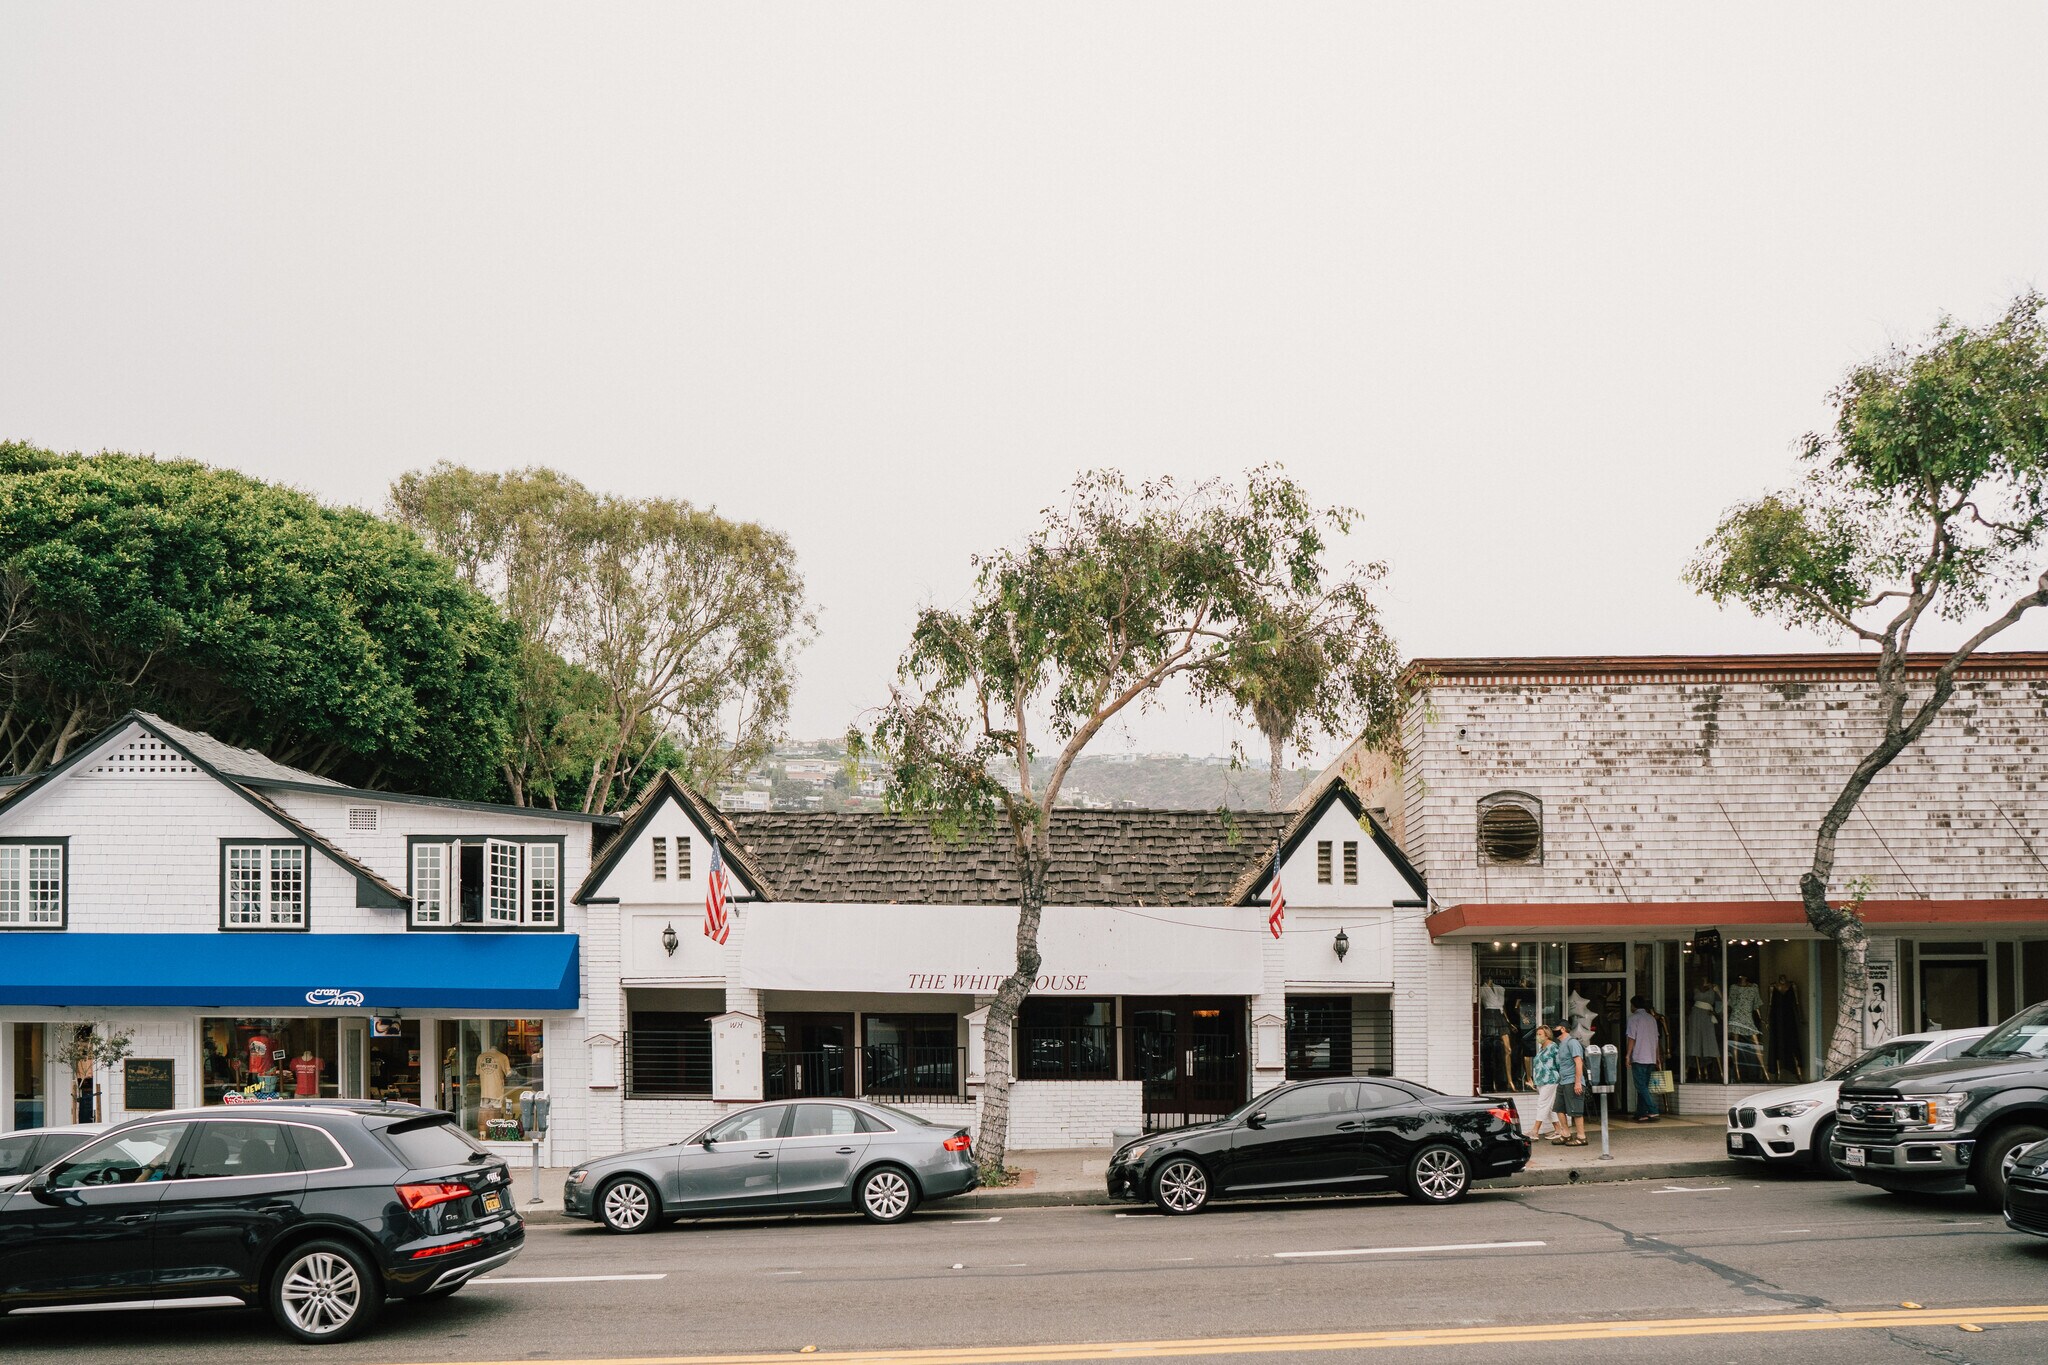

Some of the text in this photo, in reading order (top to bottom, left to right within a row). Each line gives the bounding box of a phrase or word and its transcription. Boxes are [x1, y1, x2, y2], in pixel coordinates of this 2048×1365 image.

[908, 974, 1088, 991] THE WHIT OUSE
[314, 989, 340, 998] crazy
[244, 1080, 265, 1095] NEW!
